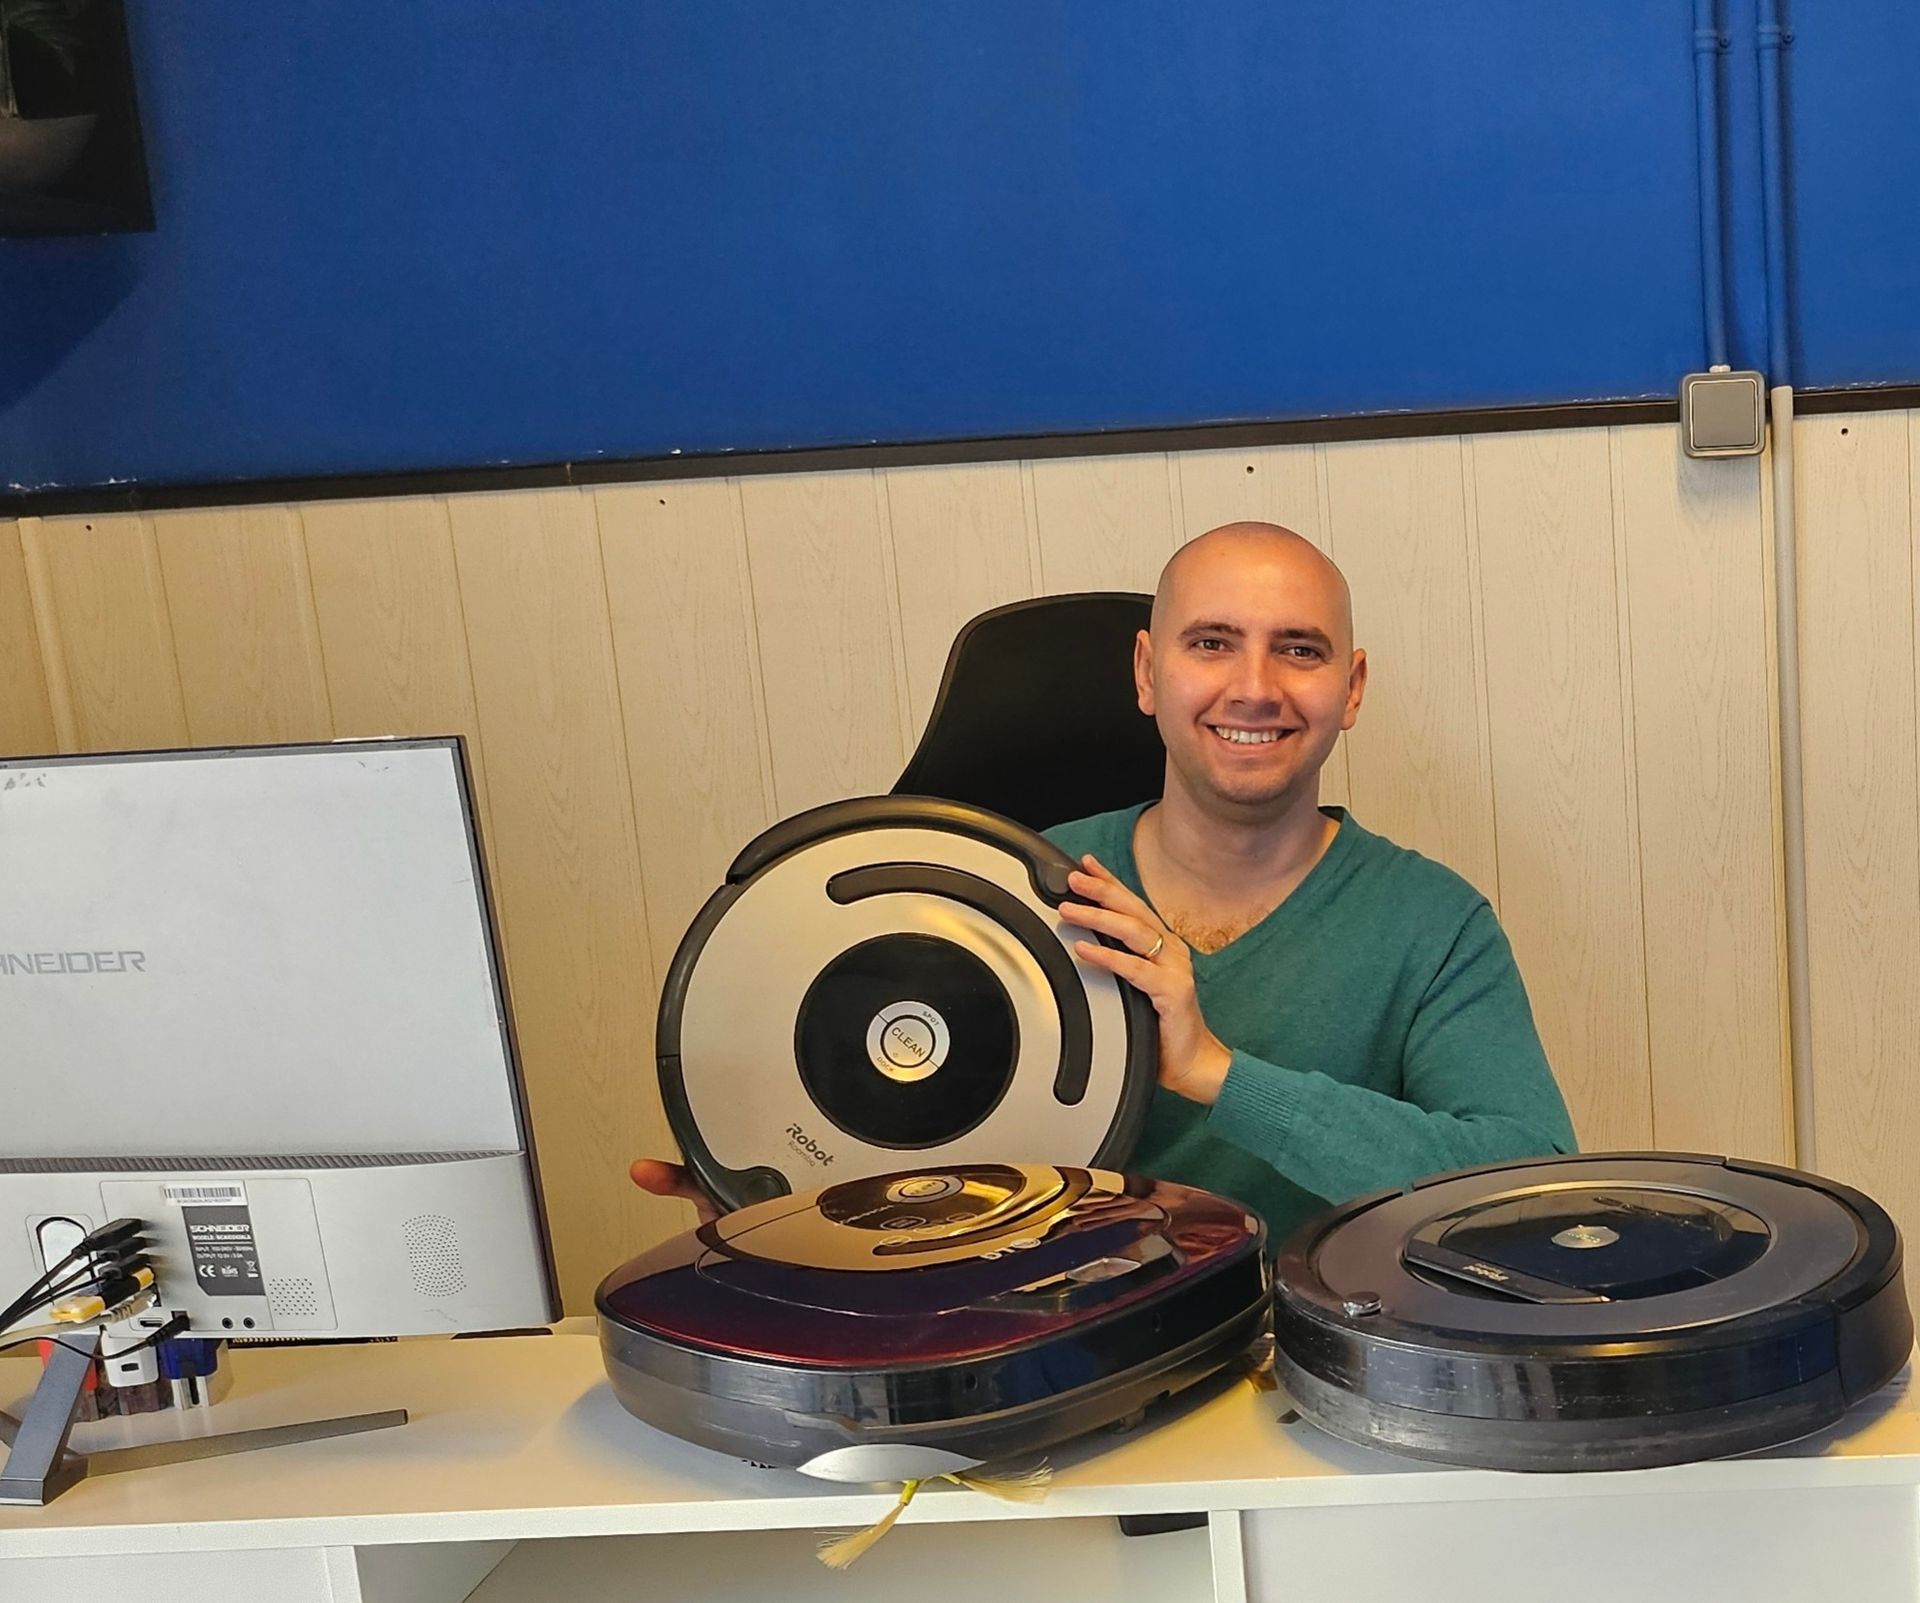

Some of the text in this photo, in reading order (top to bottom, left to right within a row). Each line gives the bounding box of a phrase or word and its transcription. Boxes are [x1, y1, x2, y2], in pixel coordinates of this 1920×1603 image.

[922, 1010, 940, 1026] SPOT
[891, 1027, 926, 1058] CLEAN
[785, 1122, 834, 1167] iRobot
[190, 1224, 250, 1233] SCHNEIDER
